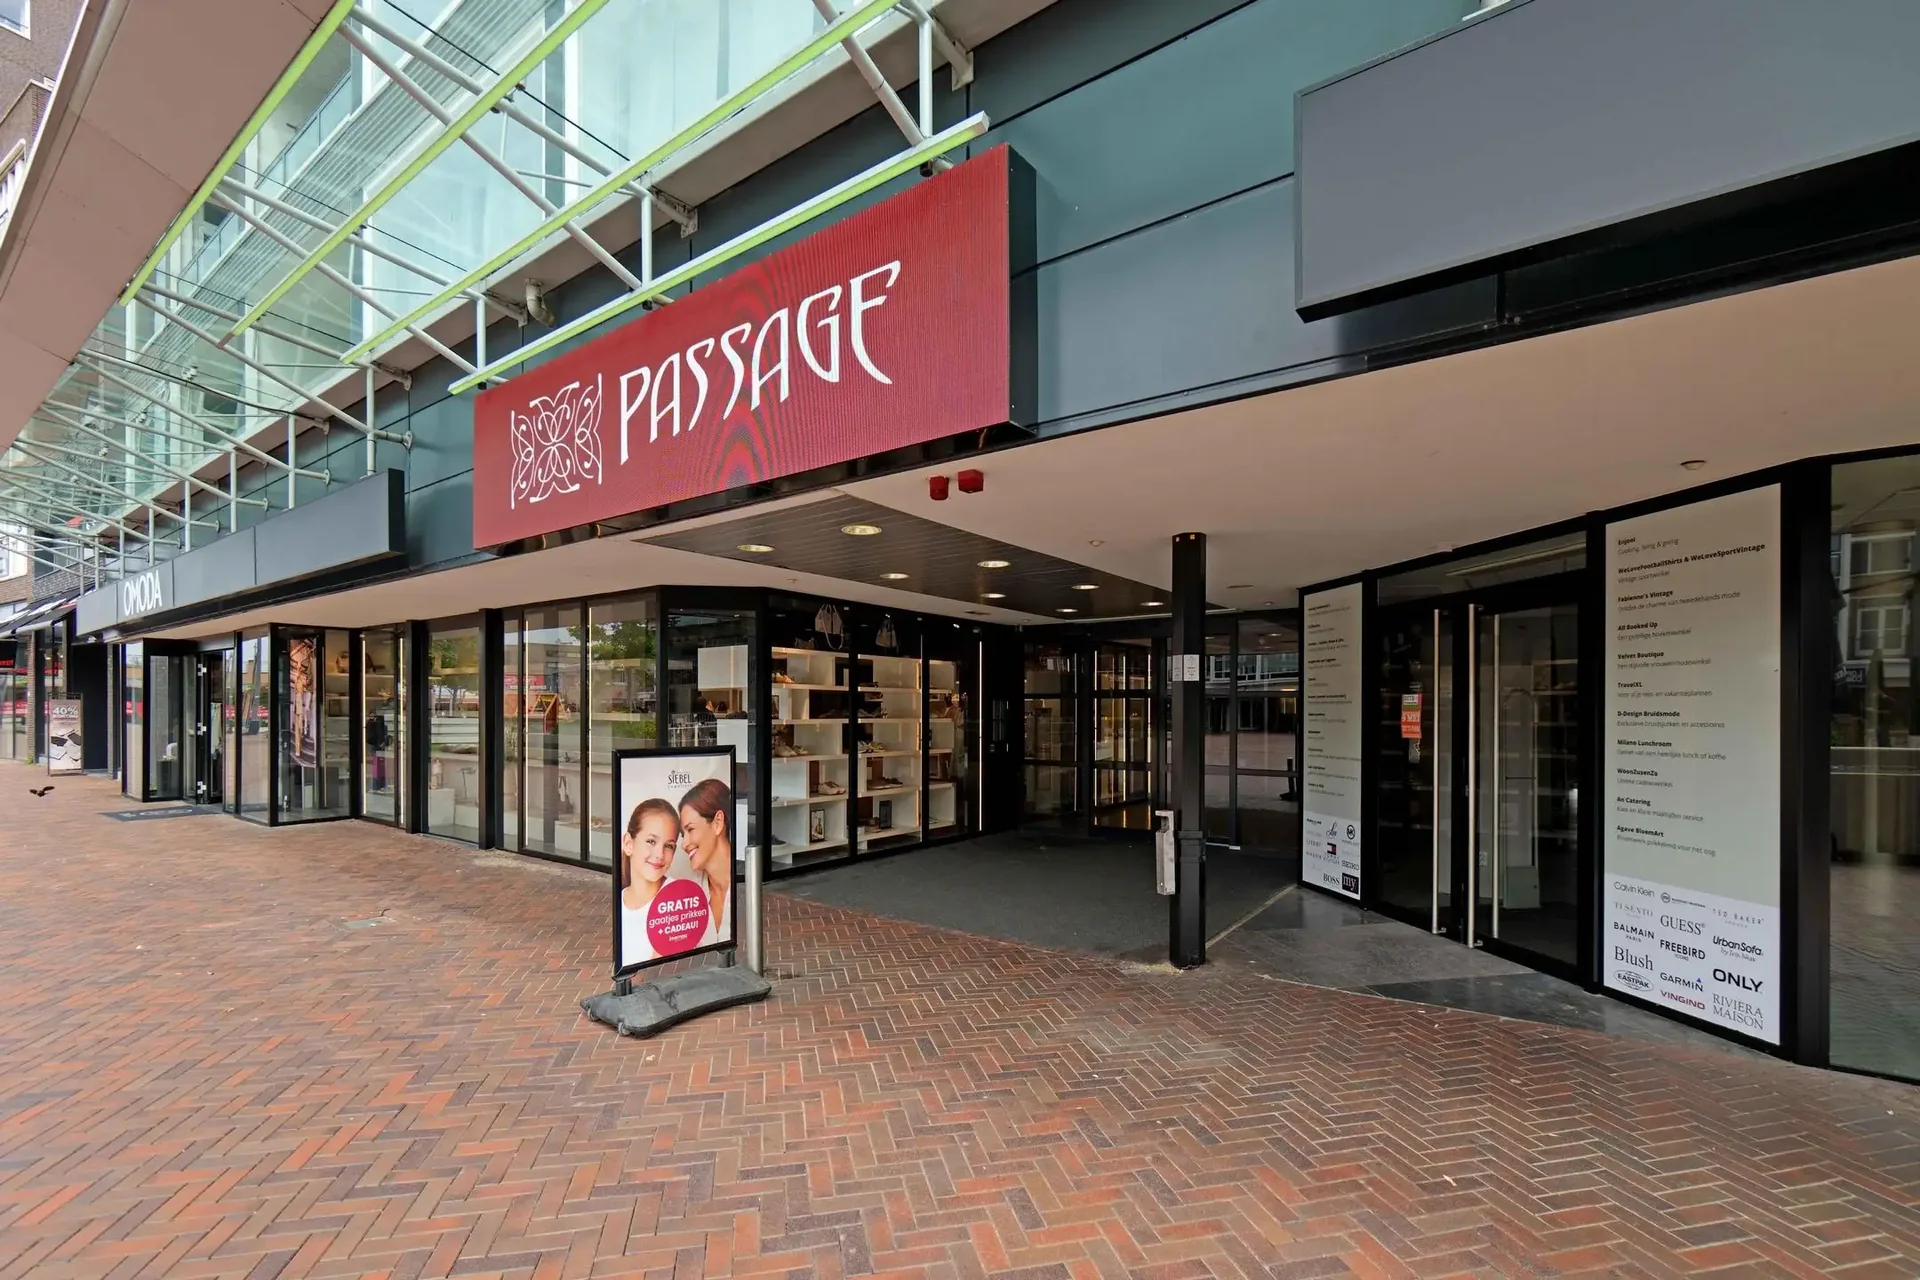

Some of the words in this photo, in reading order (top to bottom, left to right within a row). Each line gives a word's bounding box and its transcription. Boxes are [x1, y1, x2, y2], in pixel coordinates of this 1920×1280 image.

[619, 260, 901, 465] PASSAGE
[1618, 558, 1683, 574] WeLoveFootballShirts
[1690, 543, 1766, 562] WeLoveSportVintage
[124, 569, 162, 616] OMODA
[1649, 590, 1673, 599] Vintage
[1721, 591, 1740, 600] mode
[1637, 651, 1664, 660] Boutique
[52, 707, 78, 715] 40%
[668, 774, 691, 784] SIEBEL
[1626, 797, 1651, 807] Catering
[1617, 825, 1634, 833] Agave
[1636, 827, 1664, 837] BloemArt
[1323, 873, 1340, 885] BOSS
[1614, 881, 1636, 893] Calvin
[1637, 886, 1655, 897] Klein
[658, 896, 700, 914] GRATIS
[649, 914, 679, 928] gaatjes
[680, 909, 706, 922] prikken
[664, 920, 698, 934] CADEAU!
[1734, 913, 1762, 925] BAKER
[1613, 922, 1654, 939] BALMAIN
[1660, 939, 1705, 960] FREEBIRD
[1713, 935, 1762, 956] UrbanSofa
[1614, 945, 1653, 971] Blush
[1617, 973, 1650, 989] EASTPAK
[1660, 972, 1703, 992] GARMIN
[1713, 968, 1763, 992] ONLY
[1660, 989, 1705, 1010] VINGINO
[1712, 993, 1762, 1018] RIVIERA
[1713, 1004, 1764, 1030] MAISON
